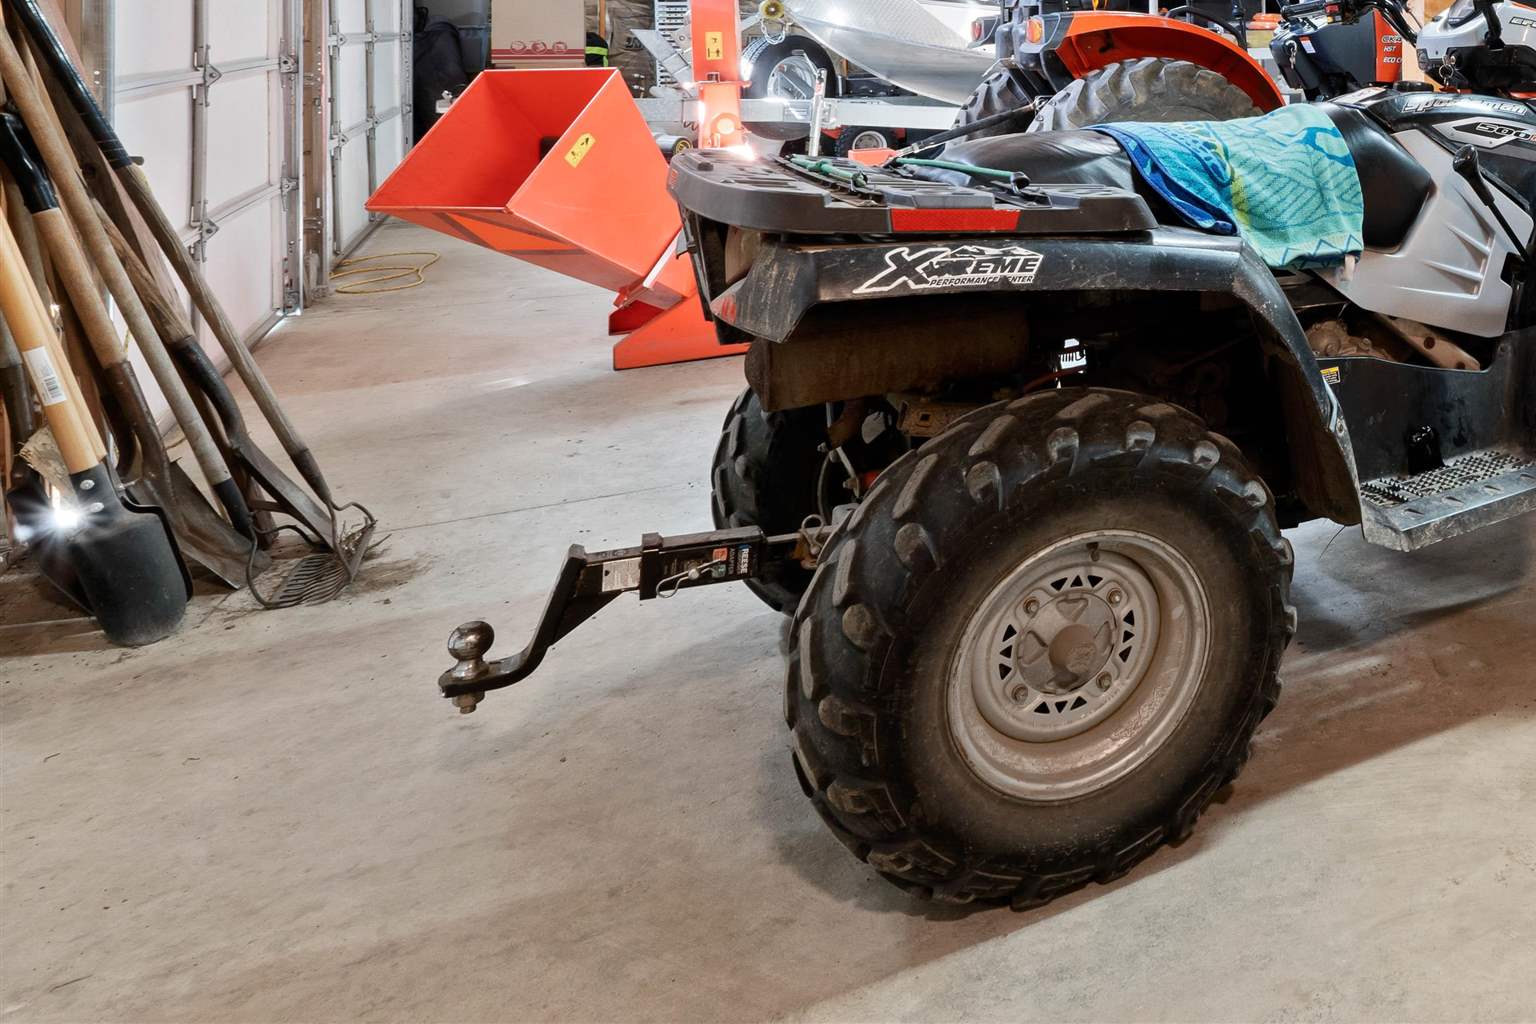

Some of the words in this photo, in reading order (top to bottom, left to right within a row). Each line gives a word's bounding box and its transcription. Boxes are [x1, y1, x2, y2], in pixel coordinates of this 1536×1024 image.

[1384, 45, 1397, 53] HST
[1384, 56, 1397, 64] ECO
[1475, 122, 1531, 141] 500
[1006, 275, 1035, 284] ENTER
[740, 548, 750, 574] REESE
